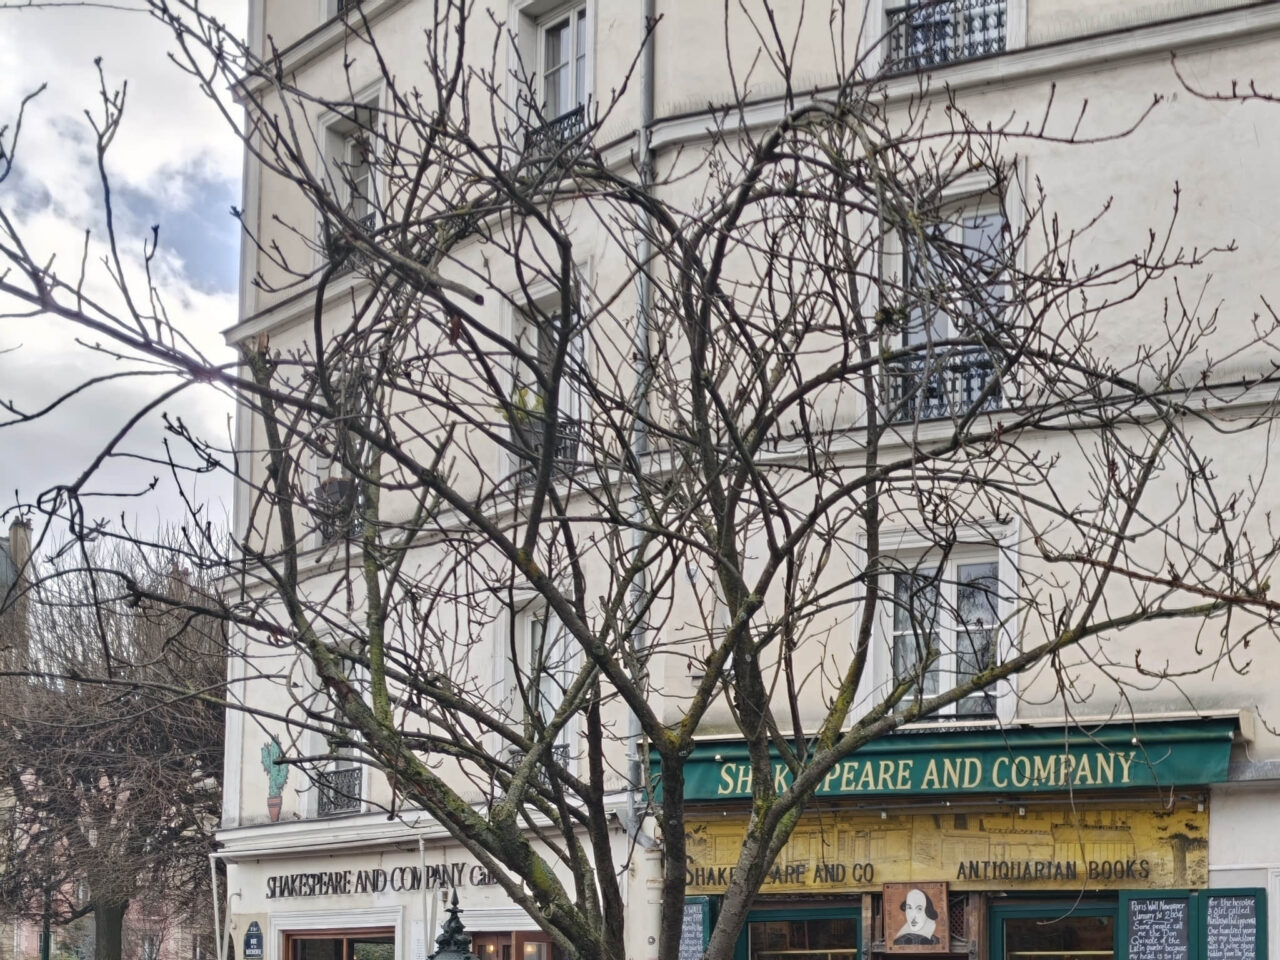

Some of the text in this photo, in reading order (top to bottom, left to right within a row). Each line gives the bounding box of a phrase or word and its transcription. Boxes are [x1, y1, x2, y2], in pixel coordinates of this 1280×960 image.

[718, 751, 1138, 796] SHKPEARE AND COMPANY
[684, 857, 875, 887] SHAKEARE AND CO
[957, 858, 1151, 882] ANTIQUARIAN BOOKS
[266, 870, 352, 900] SHAKESPEARE
[354, 868, 388, 894] AND
[390, 862, 468, 893] COMPANY
[1132, 900, 1147, 911] Paris
[1228, 906, 1250, 915] called
[1133, 921, 1150, 930] Some
[1162, 928, 1177, 937] Don
